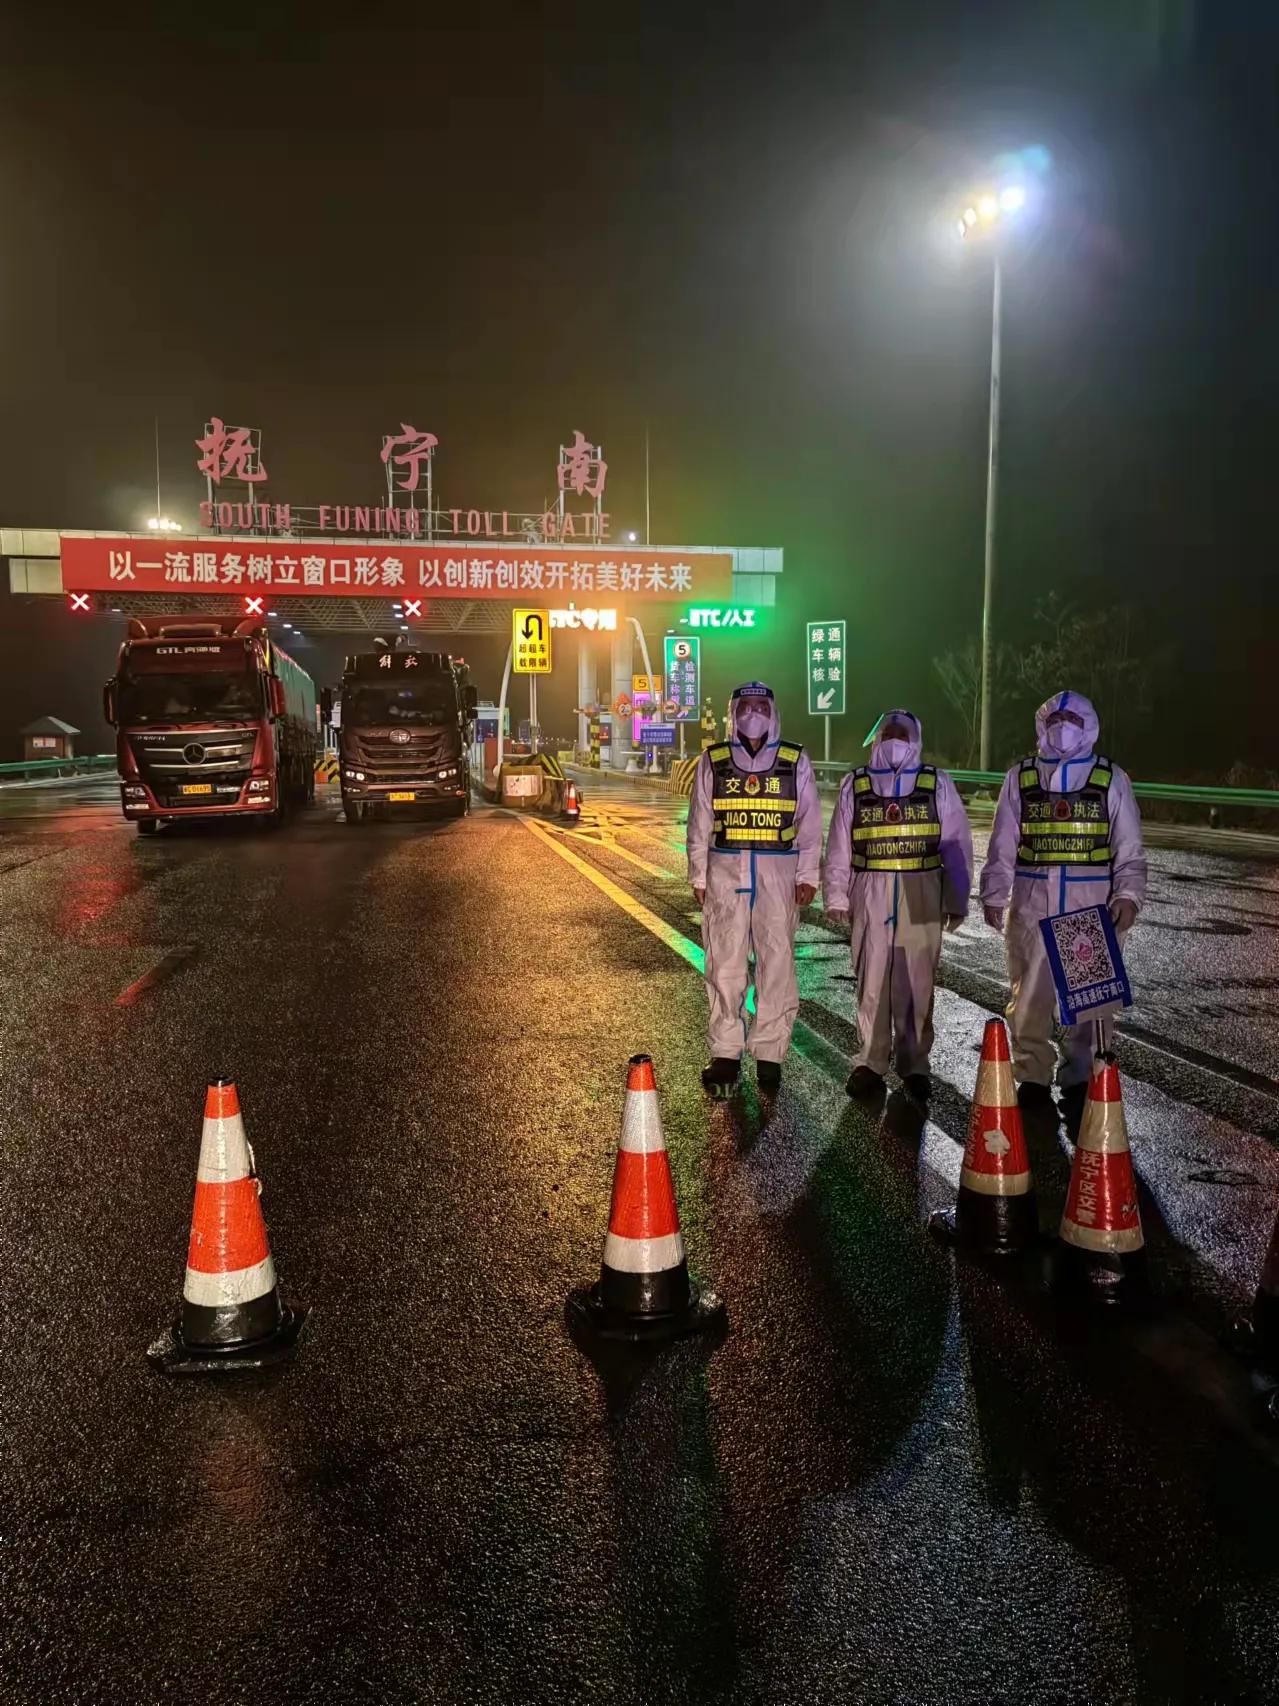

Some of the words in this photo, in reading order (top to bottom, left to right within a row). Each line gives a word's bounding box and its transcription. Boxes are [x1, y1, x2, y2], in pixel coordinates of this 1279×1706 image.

[199, 502, 291, 529] SOUTH
[319, 505, 420, 535] FUNING
[452, 509, 514, 536] TOLL
[541, 512, 611, 538] GATE
[108, 549, 406, 588] 以一流服务树立窗口形象
[418, 557, 693, 592] 以创新创效开拓美好未来
[811, 627, 841, 643] 绿通
[811, 648, 841, 662] 车辆
[812, 667, 841, 682] 核验
[860, 807, 884, 823] 交通
[904, 804, 929, 820] 执法
[1027, 802, 1052, 818] 交通
[1073, 801, 1100, 818] 执法
[723, 812, 748, 826] JIAO
[751, 812, 781, 827] TONG
